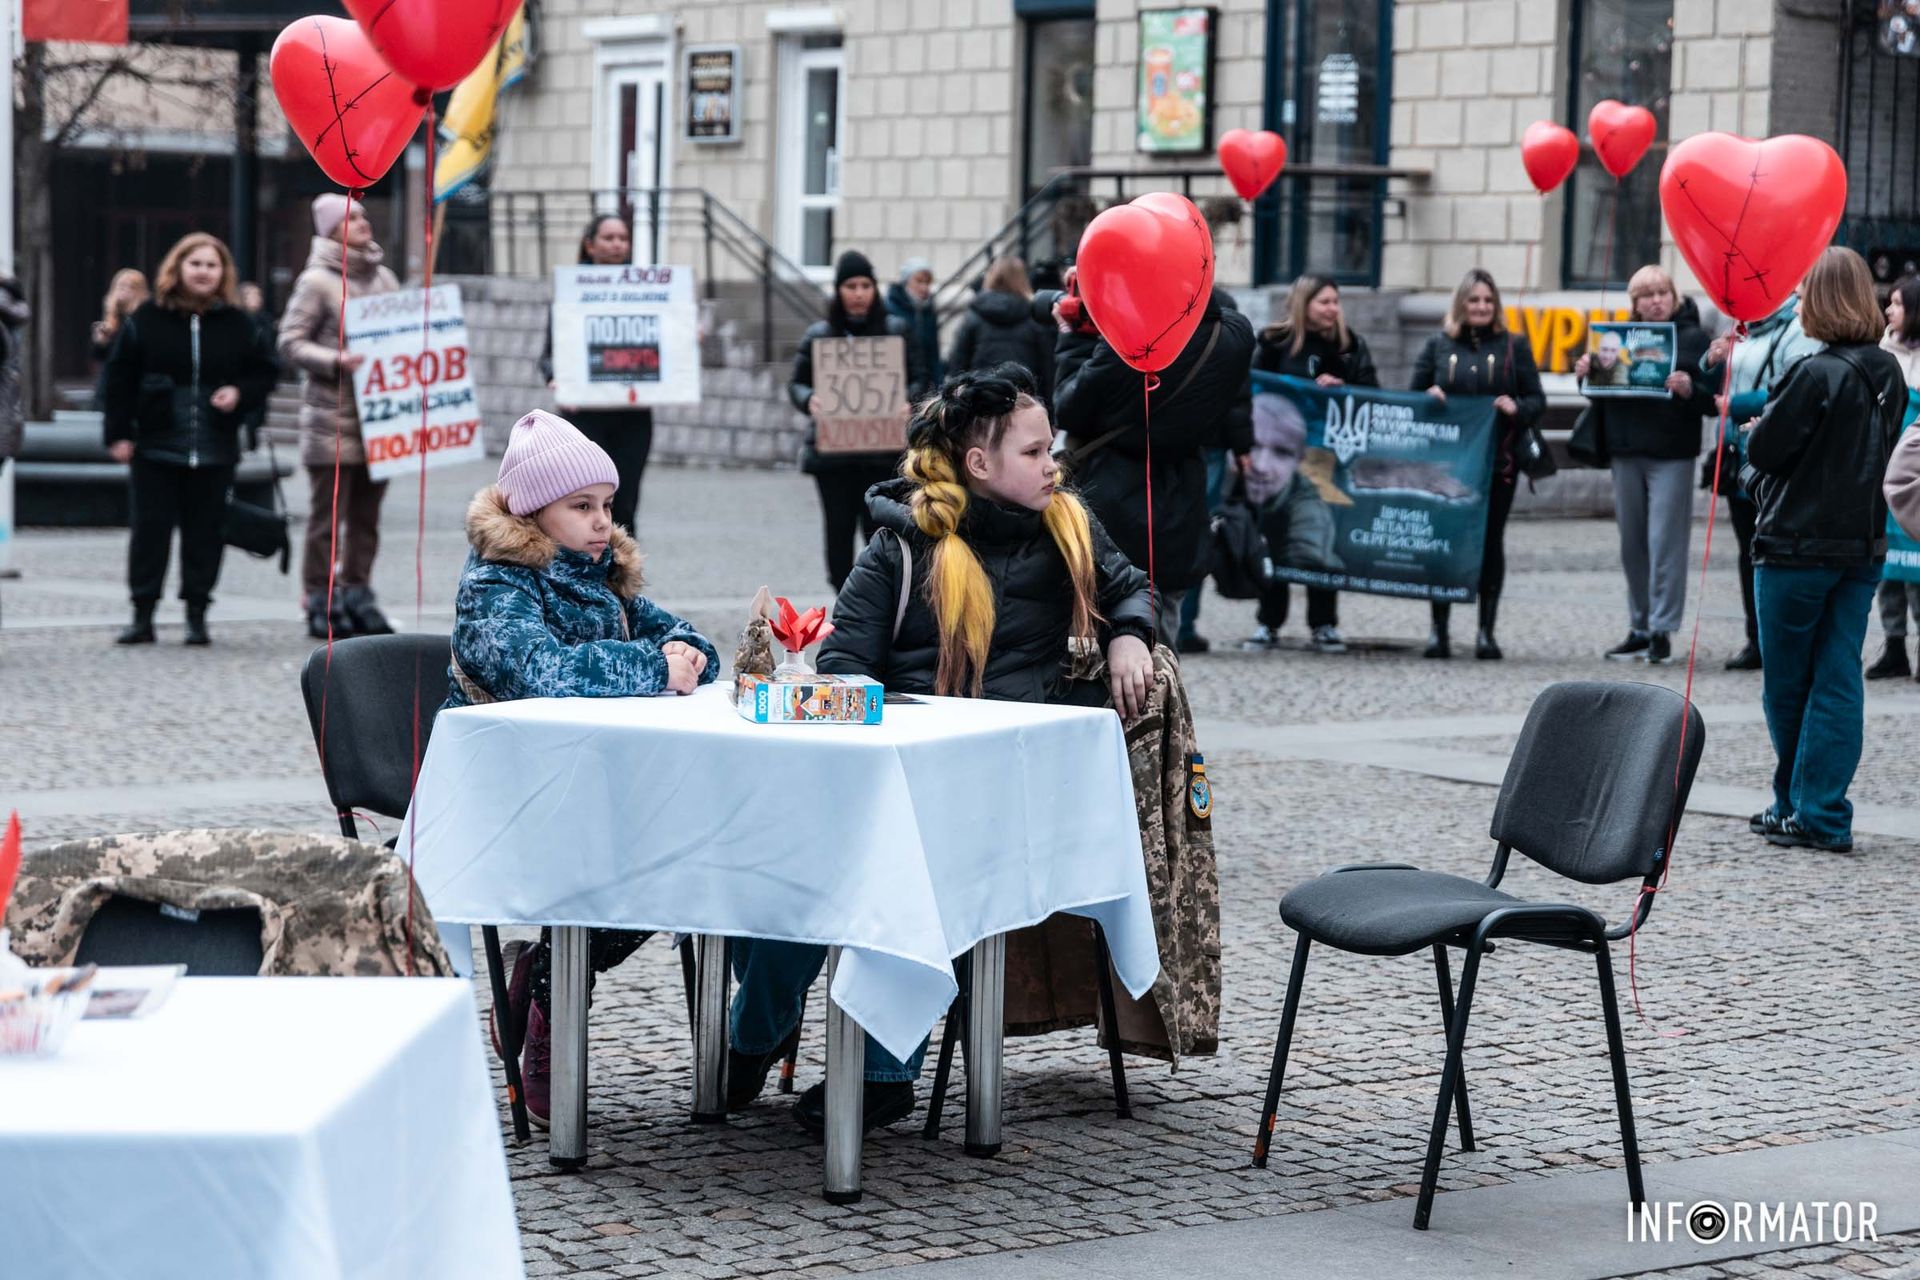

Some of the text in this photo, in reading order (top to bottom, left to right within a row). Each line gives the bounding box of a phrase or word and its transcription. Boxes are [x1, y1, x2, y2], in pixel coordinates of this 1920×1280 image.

[619, 267, 672, 284] АЗОВ
[586, 315, 659, 344] ПОЛОН
[819, 337, 887, 369] FREE
[363, 347, 468, 395] АЗОВ
[824, 371, 900, 414] 3057
[363, 398, 395, 422] 22
[367, 418, 480, 464] ПОЛОНУ
[758, 691, 767, 713] 1000
